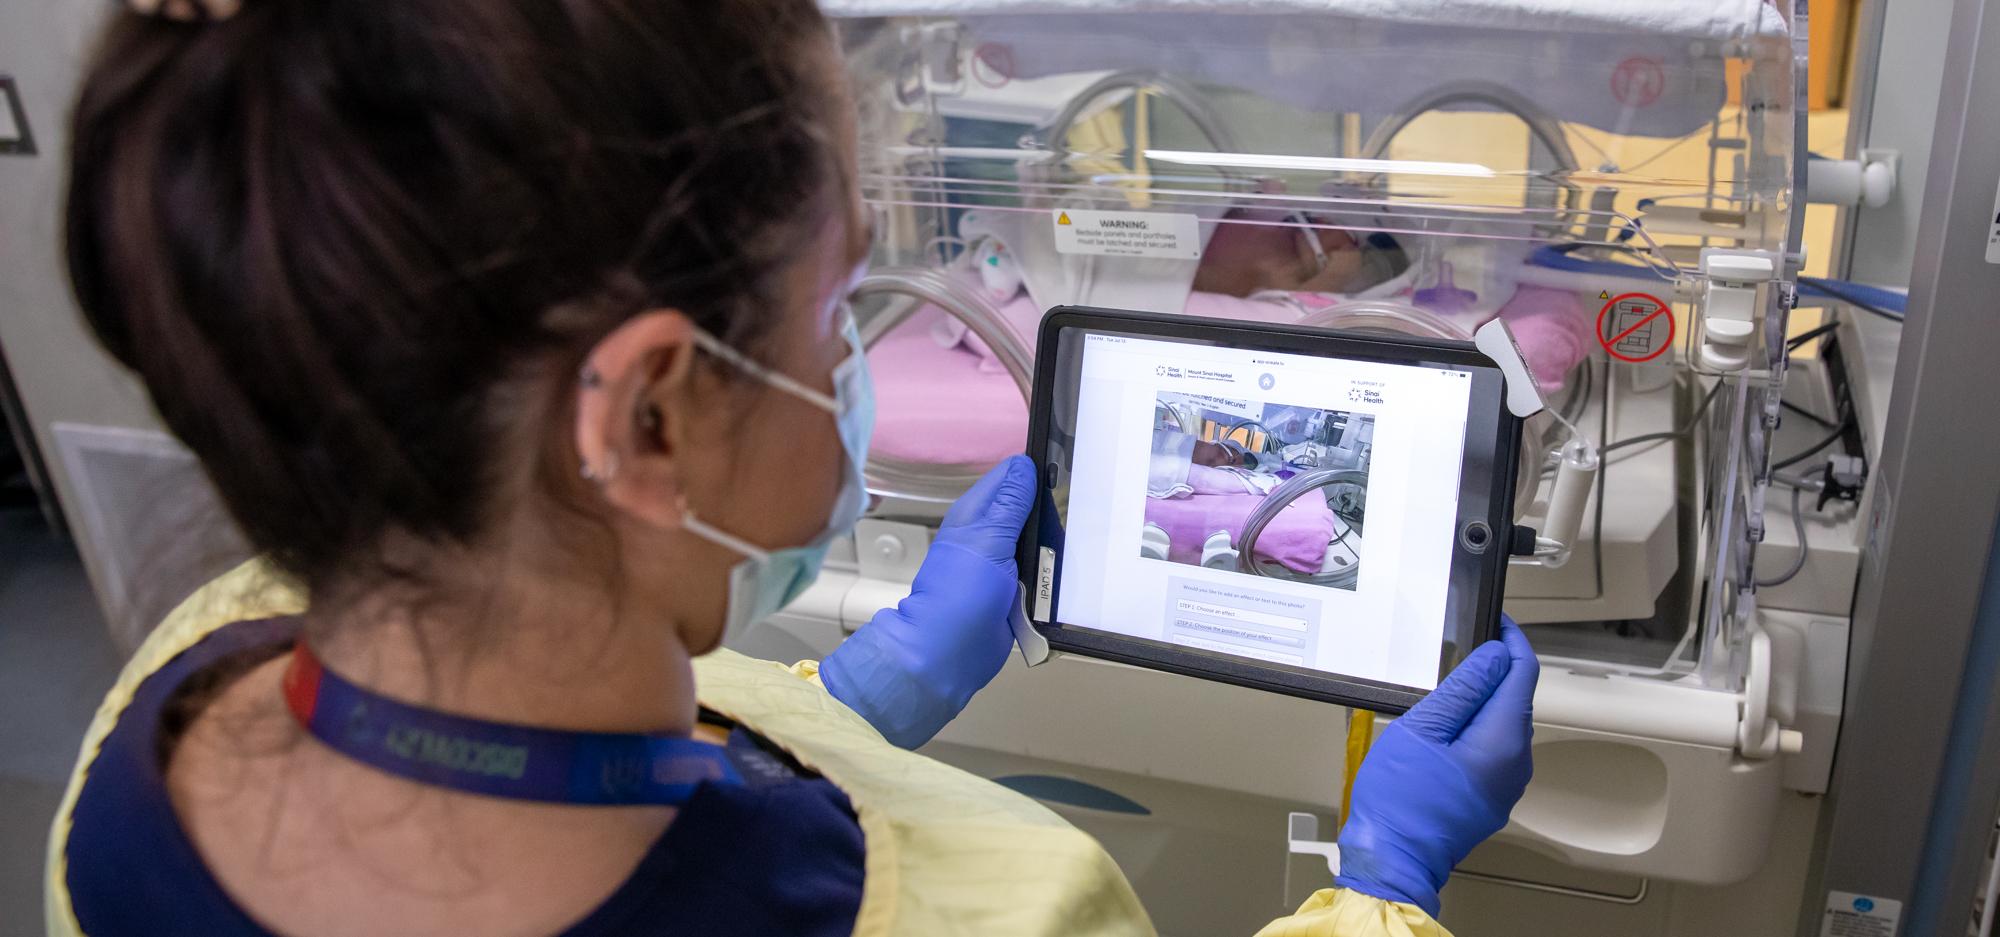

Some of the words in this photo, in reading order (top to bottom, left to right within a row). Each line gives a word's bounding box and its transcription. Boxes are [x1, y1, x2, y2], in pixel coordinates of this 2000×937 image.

[1100, 219, 1149, 230] WARNING:
[1103, 230, 1126, 238] panels
[1143, 232, 1176, 241] portholes
[1106, 239, 1132, 247] latched
[1225, 400, 1246, 409] secured
[1041, 576, 1050, 600] IPAD
[1221, 628, 1240, 636] position
